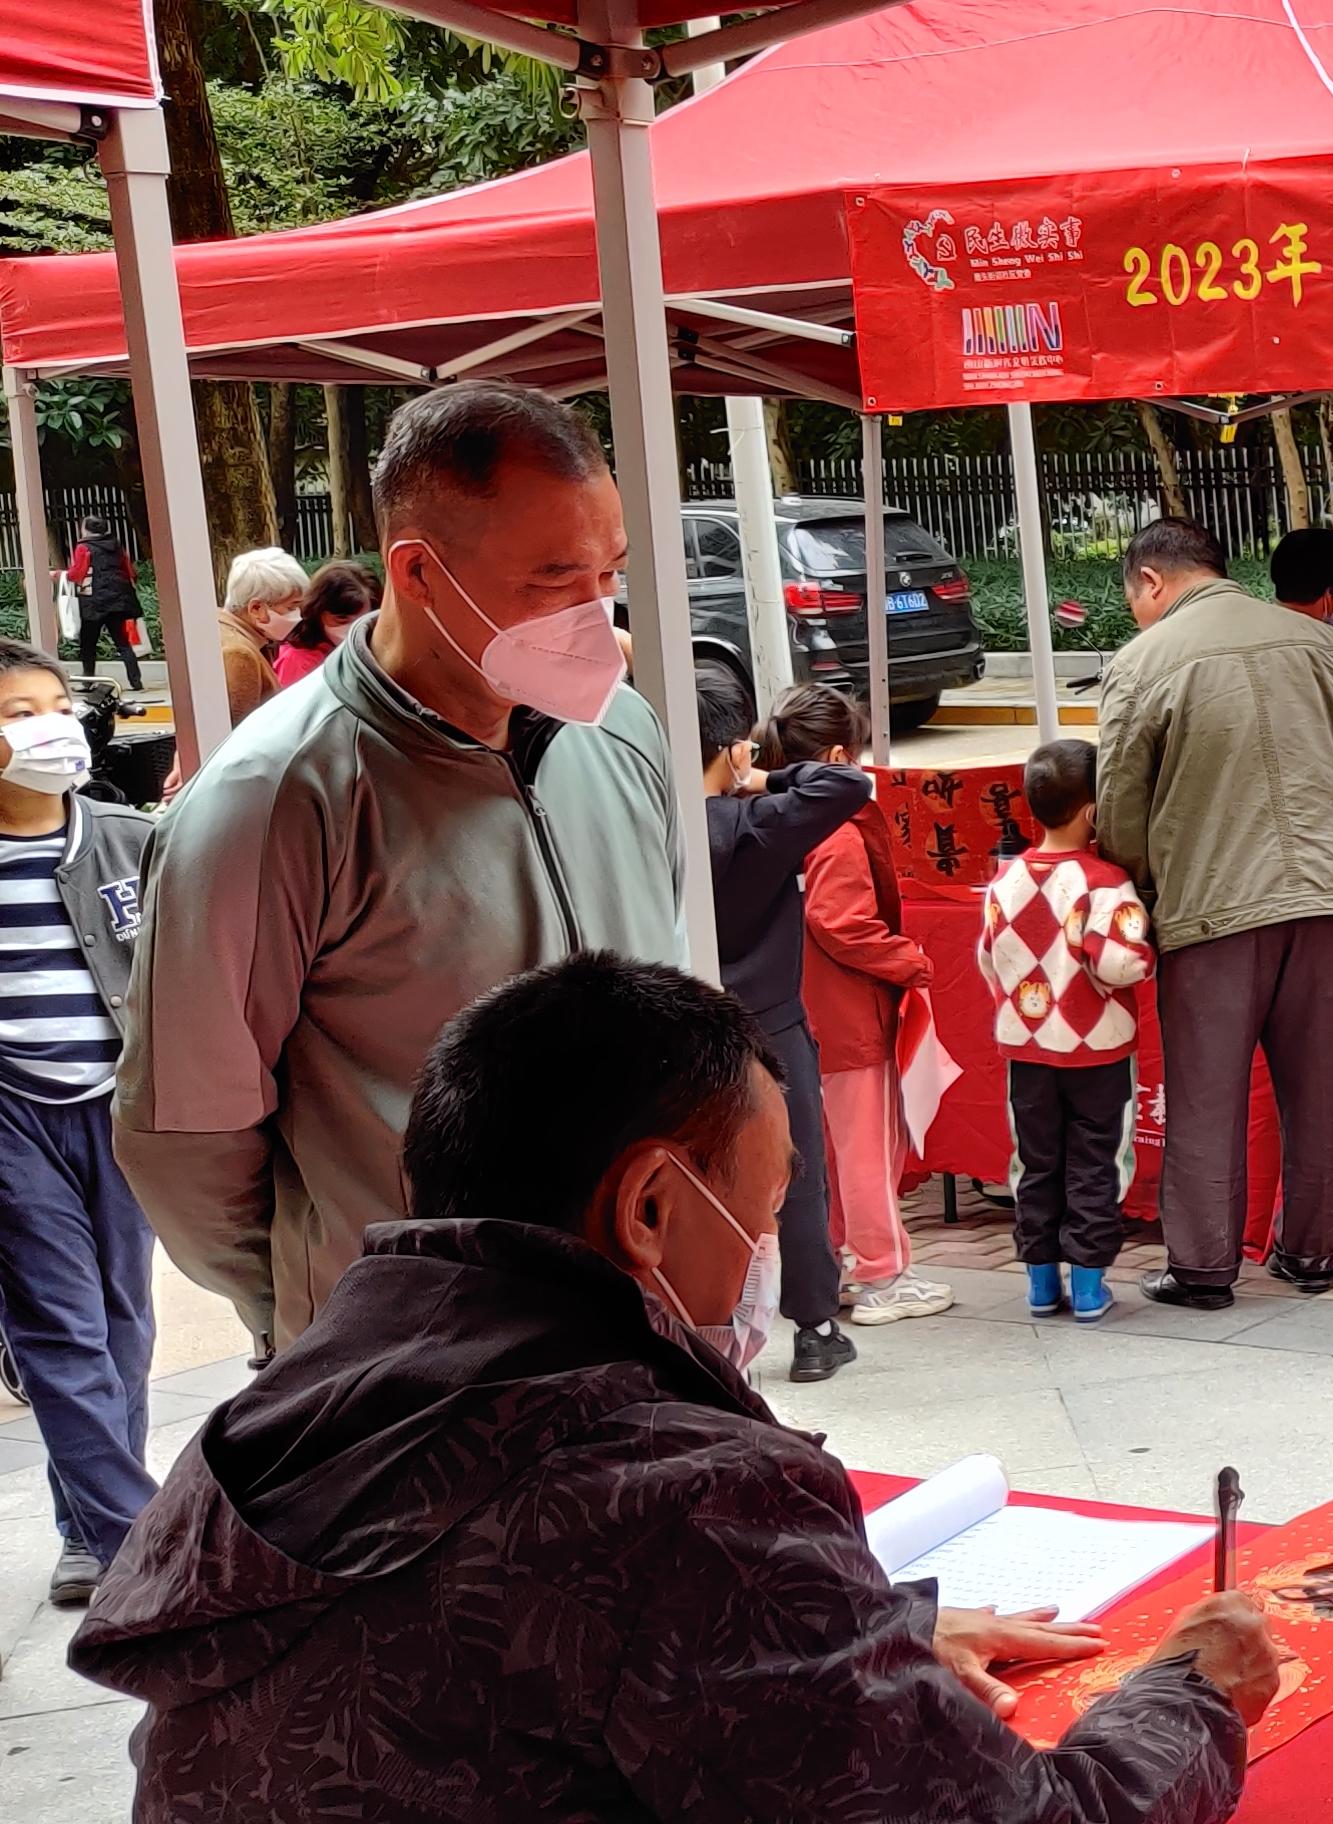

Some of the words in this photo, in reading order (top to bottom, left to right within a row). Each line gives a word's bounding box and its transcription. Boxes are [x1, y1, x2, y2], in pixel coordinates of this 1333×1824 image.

[1024, 253, 1045, 264] Wei
[1047, 251, 1064, 262] Shi
[1067, 249, 1084, 261] Shi
[886, 592, 928, 611] B·6T6D2
